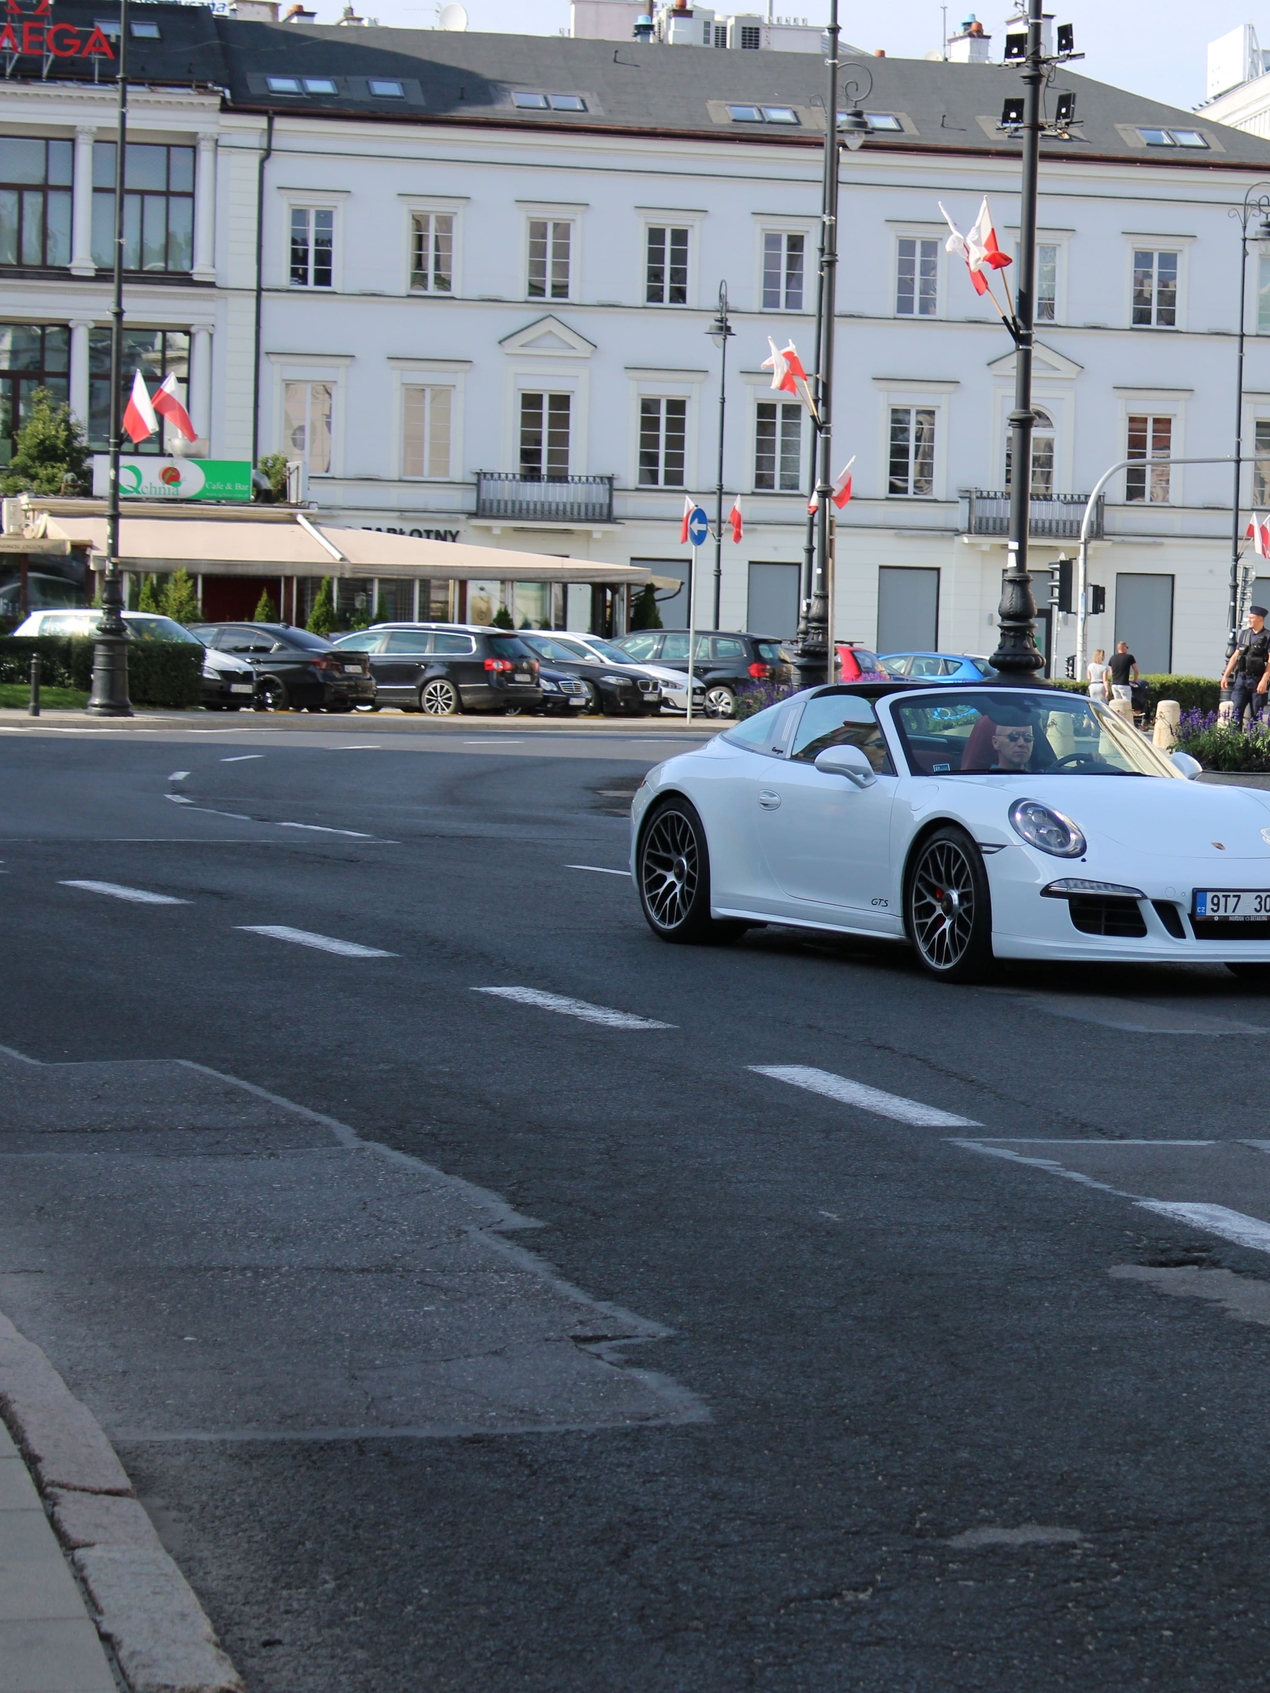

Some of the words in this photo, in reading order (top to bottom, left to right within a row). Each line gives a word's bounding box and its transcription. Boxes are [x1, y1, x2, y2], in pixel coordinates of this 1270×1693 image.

[205, 481, 224, 490] Cafe
[225, 482, 233, 490] &
[234, 482, 249, 491] Bar
[871, 898, 889, 907] GTS
[1210, 894, 1241, 913] 9T7
